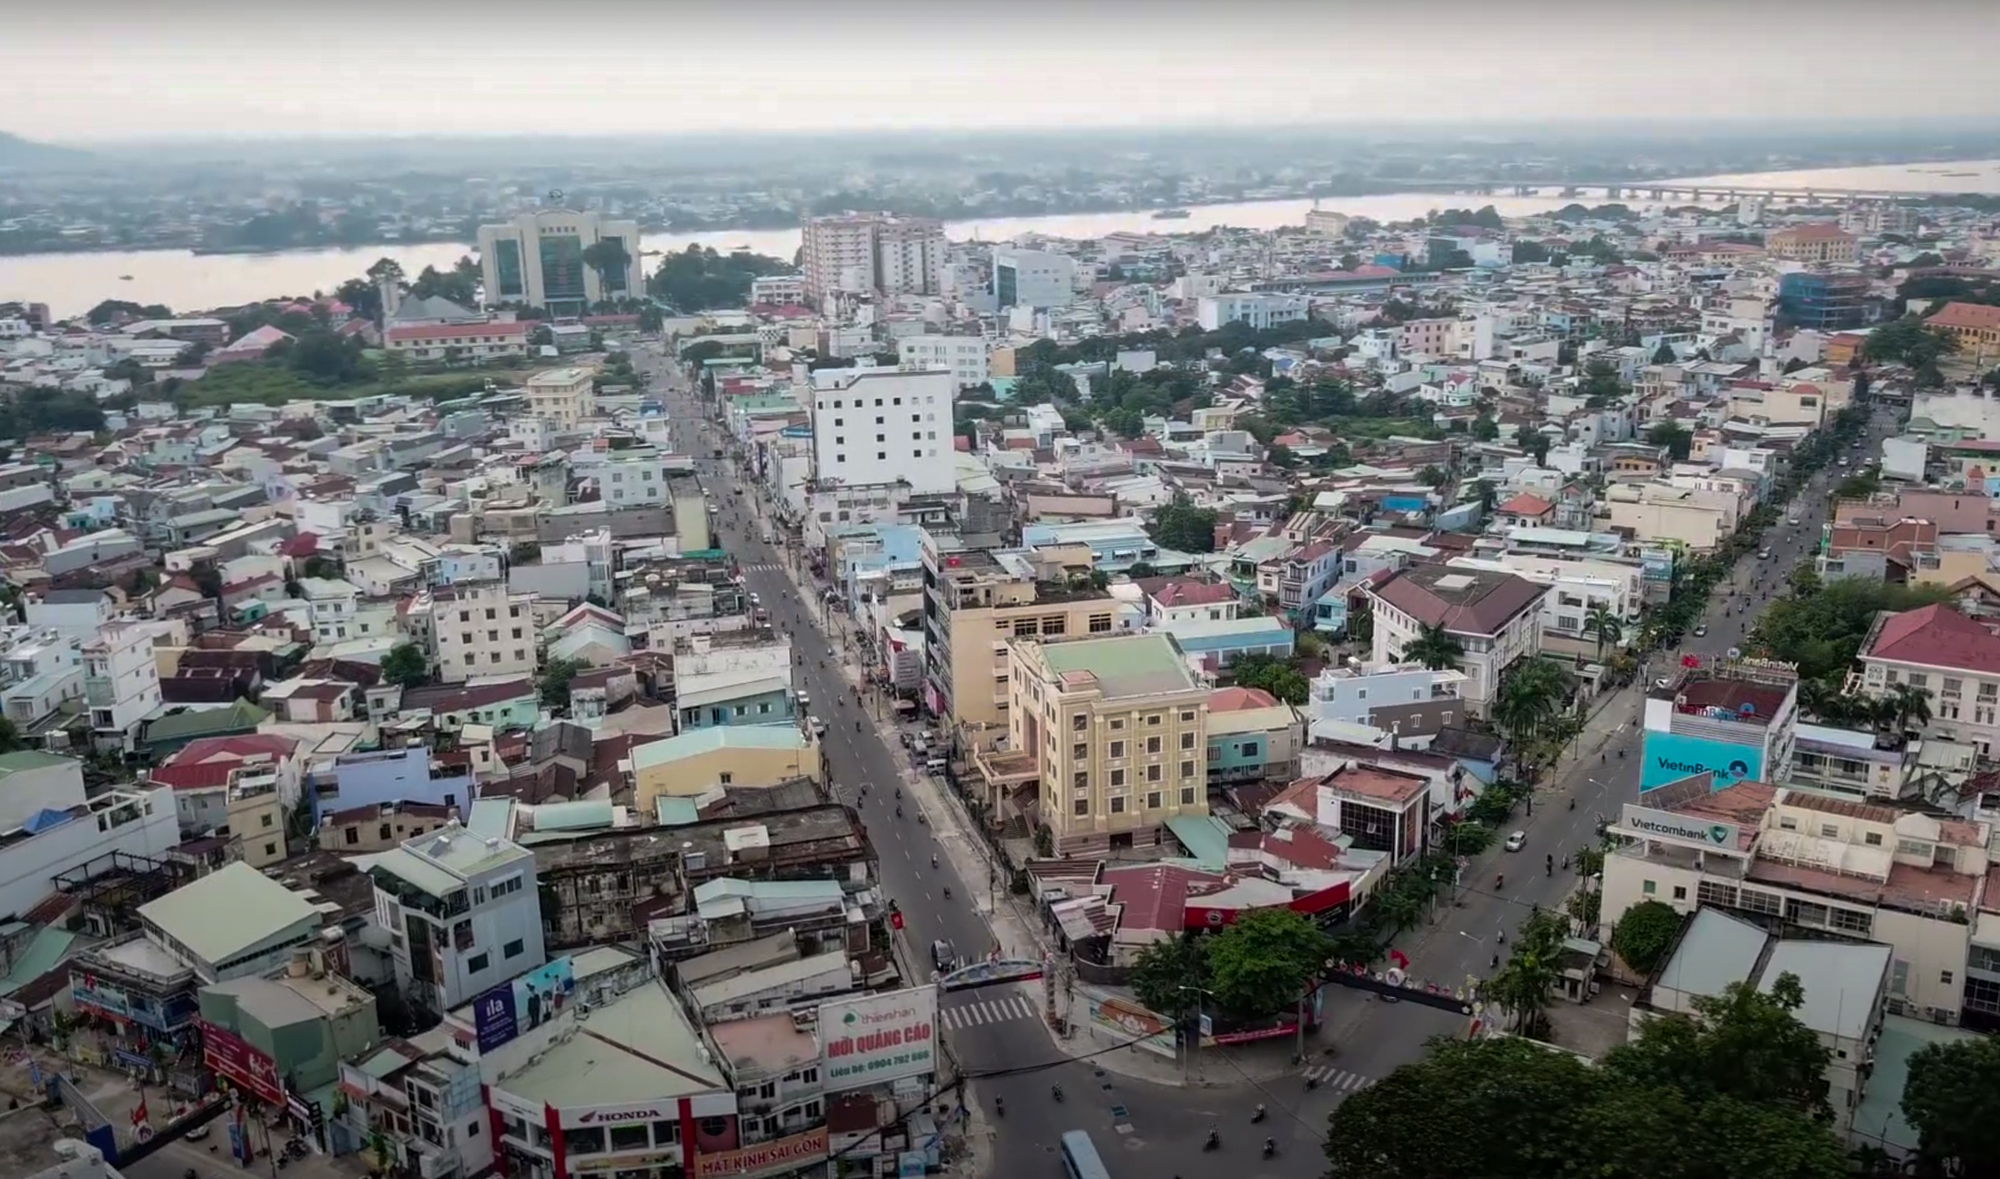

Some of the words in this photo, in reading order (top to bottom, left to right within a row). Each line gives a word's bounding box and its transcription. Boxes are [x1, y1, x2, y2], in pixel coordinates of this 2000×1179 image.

[1631, 817, 1709, 841] Vietcombank
[856, 1028, 902, 1053] QUẢNG
[904, 1021, 931, 1043] CÁO
[597, 1109, 661, 1122] HONDA
